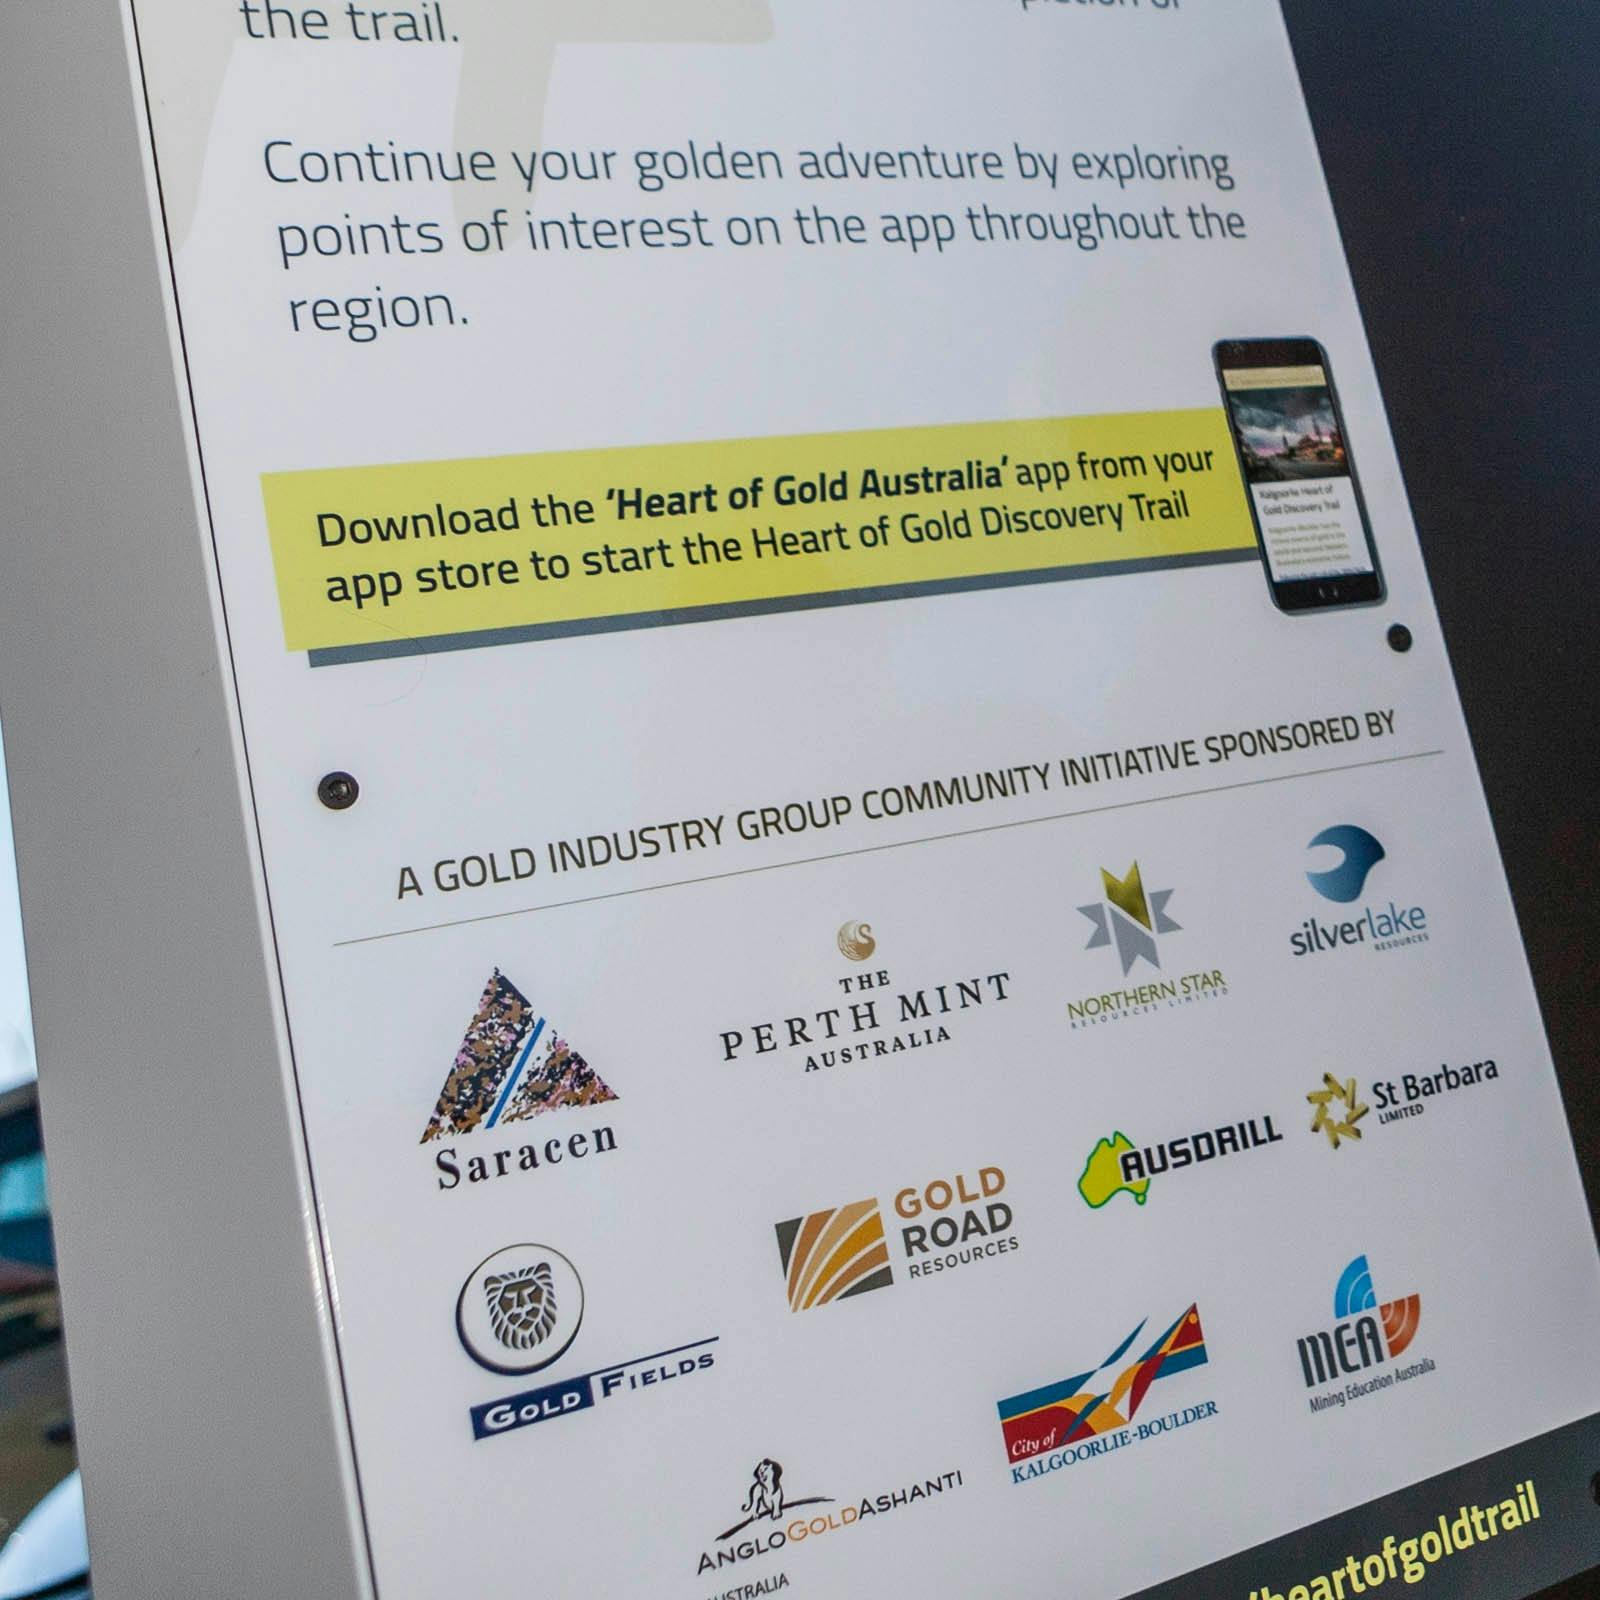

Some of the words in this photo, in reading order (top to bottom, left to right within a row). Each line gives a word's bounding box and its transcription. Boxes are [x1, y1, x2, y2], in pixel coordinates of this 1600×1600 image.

[344, 0, 459, 43] trail.
[263, 139, 498, 184] Continue
[510, 150, 618, 194] your
[633, 139, 784, 193] golden
[797, 141, 1005, 180] adventure
[1013, 141, 1059, 190] by
[1071, 143, 1236, 192] exploring
[277, 212, 445, 271] points
[461, 207, 509, 253] of
[524, 209, 715, 251] interest
[725, 215, 782, 247] on
[793, 204, 868, 246] the
[879, 213, 956, 254] app
[964, 202, 1181, 252] throughout
[1185, 202, 1248, 240] the
[288, 285, 469, 344] region.
[316, 496, 521, 548] Download
[529, 492, 596, 528] the
[727, 476, 764, 511] of
[772, 469, 849, 507] Gold
[1014, 460, 1071, 493] app
[1075, 450, 1148, 481] from
[1152, 449, 1214, 483] your
[325, 570, 403, 610] app
[414, 558, 520, 594] store
[528, 549, 571, 582] to
[581, 538, 676, 577] start
[681, 531, 744, 566] the
[750, 521, 852, 559] Heart
[858, 513, 891, 549] of
[899, 507, 973, 544] Gold
[979, 501, 1123, 537] Discovery
[1126, 488, 1191, 522] Trail
[396, 865, 424, 901] A
[432, 846, 537, 893] GOLD
[547, 813, 725, 874] INDUSTRY
[735, 794, 853, 842] GROUP
[861, 761, 1051, 821] COMMUNITY
[1058, 738, 1201, 788] INITIATIVE
[1203, 714, 1361, 764] SPONSORED
[1363, 708, 1395, 738] BY
[1290, 901, 1427, 957] silverlake
[1374, 931, 1430, 952] RESOURCES
[838, 968, 891, 995] THE
[1067, 979, 1177, 1020] NORTHERN
[1180, 969, 1226, 995] STAR
[719, 998, 882, 1061] PERTH
[898, 971, 1013, 1022] MINT
[803, 1025, 953, 1073] AUSTRALIA
[1372, 1079, 1400, 1109] St
[1401, 1058, 1500, 1102] Barbara
[1378, 1102, 1425, 1125] LIMITED
[435, 1122, 620, 1191] Saracen
[1120, 1114, 1284, 1183] AUSDRILL
[894, 1165, 1006, 1220] GOLD
[901, 1202, 1013, 1258] ROAD
[908, 1236, 1020, 1279] RESOURCES
[1309, 1390, 1346, 1414] Mining
[1345, 1373, 1394, 1401] Education
[1394, 1357, 1437, 1384] Australia
[1009, 1399, 1219, 1485] KALGOORLIE-BOULDER
[1011, 1437, 1041, 1458] City
[1042, 1427, 1057, 1449] of
